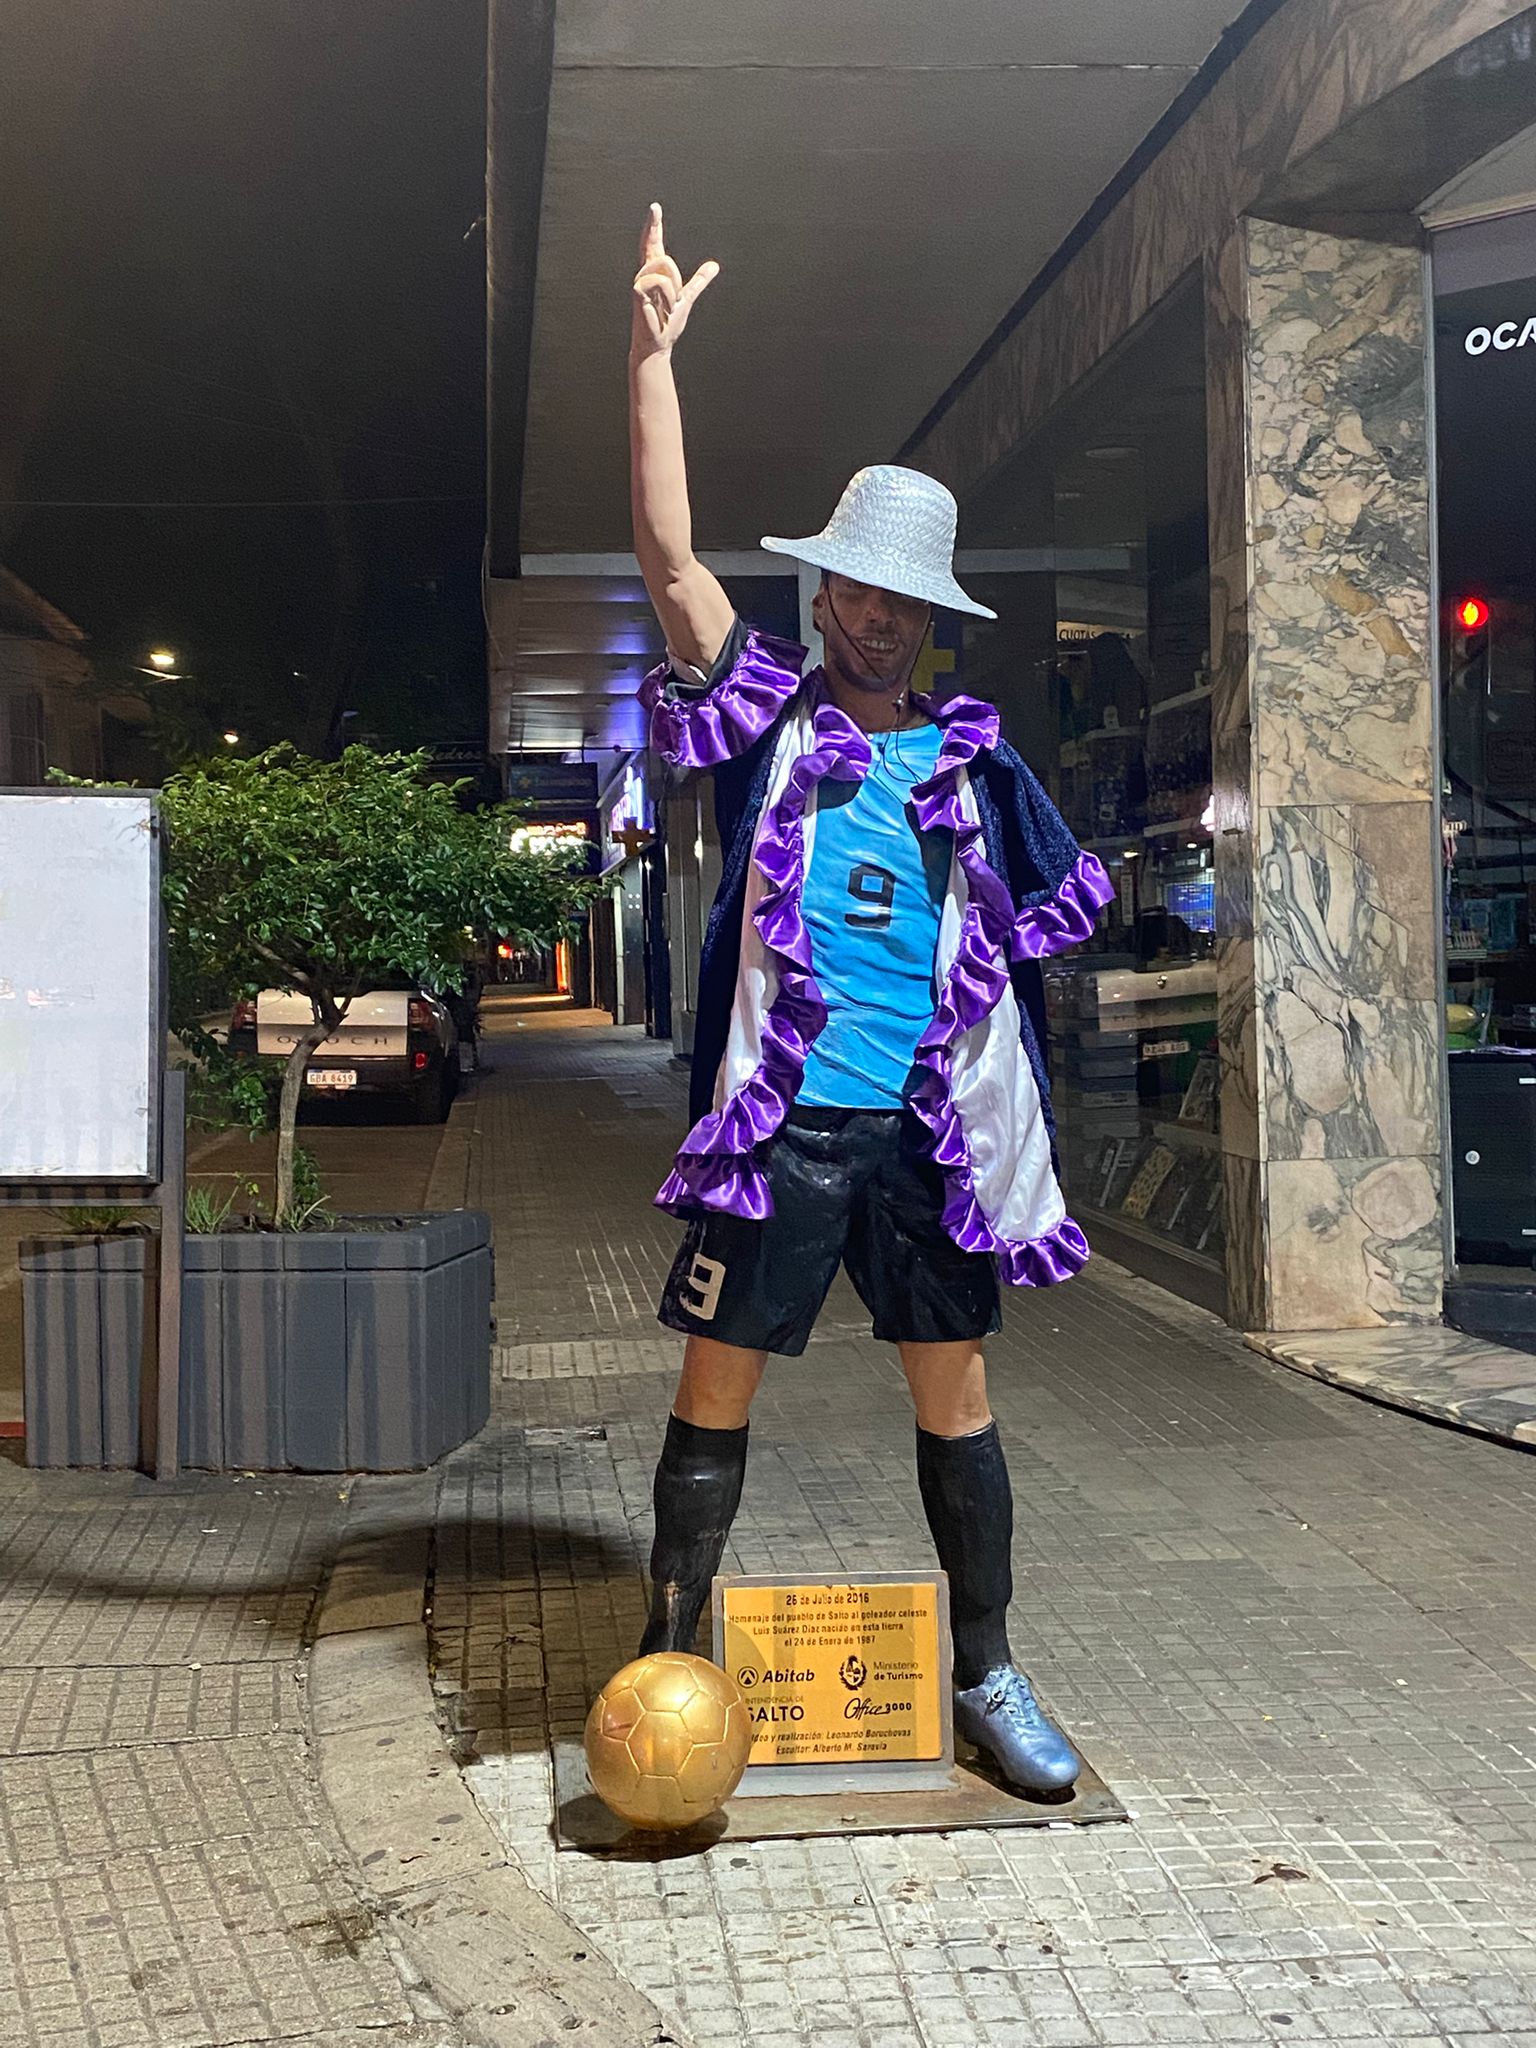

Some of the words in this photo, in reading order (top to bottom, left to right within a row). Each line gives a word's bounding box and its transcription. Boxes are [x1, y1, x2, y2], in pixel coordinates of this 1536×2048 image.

[844, 863, 897, 930] 9
[277, 1035, 388, 1045] OOCH
[679, 1252, 727, 1321] 9
[786, 1594, 798, 1606] 26
[834, 1593, 844, 1604] de
[846, 1592, 870, 1604] 2016
[728, 1613, 770, 1624] Homenaje
[771, 1612, 785, 1623] del
[786, 1611, 814, 1623] pueblo
[816, 1611, 826, 1621] de
[828, 1610, 849, 1621] Salto
[851, 1610, 859, 1620] al
[861, 1609, 896, 1621] goleador
[898, 1607, 928, 1618] celeste
[753, 1626, 770, 1636] Luis
[772, 1624, 799, 1635] Suárez
[821, 1623, 849, 1633] nacido
[850, 1624, 861, 1633] en
[862, 1622, 880, 1632] esta
[881, 1621, 904, 1632] tierra
[784, 1638, 792, 1647] el
[794, 1637, 805, 1647] 24
[807, 1637, 816, 1646] de
[843, 1635, 854, 1645] de
[856, 1635, 876, 1644] 1987
[873, 1661, 919, 1671] Ministerio
[761, 1668, 815, 1684] Abitab
[873, 1672, 885, 1682] de
[886, 1671, 924, 1681] Turismo
[825, 1730, 864, 1741] Leonardo
[812, 1742, 842, 1754] Alberto
